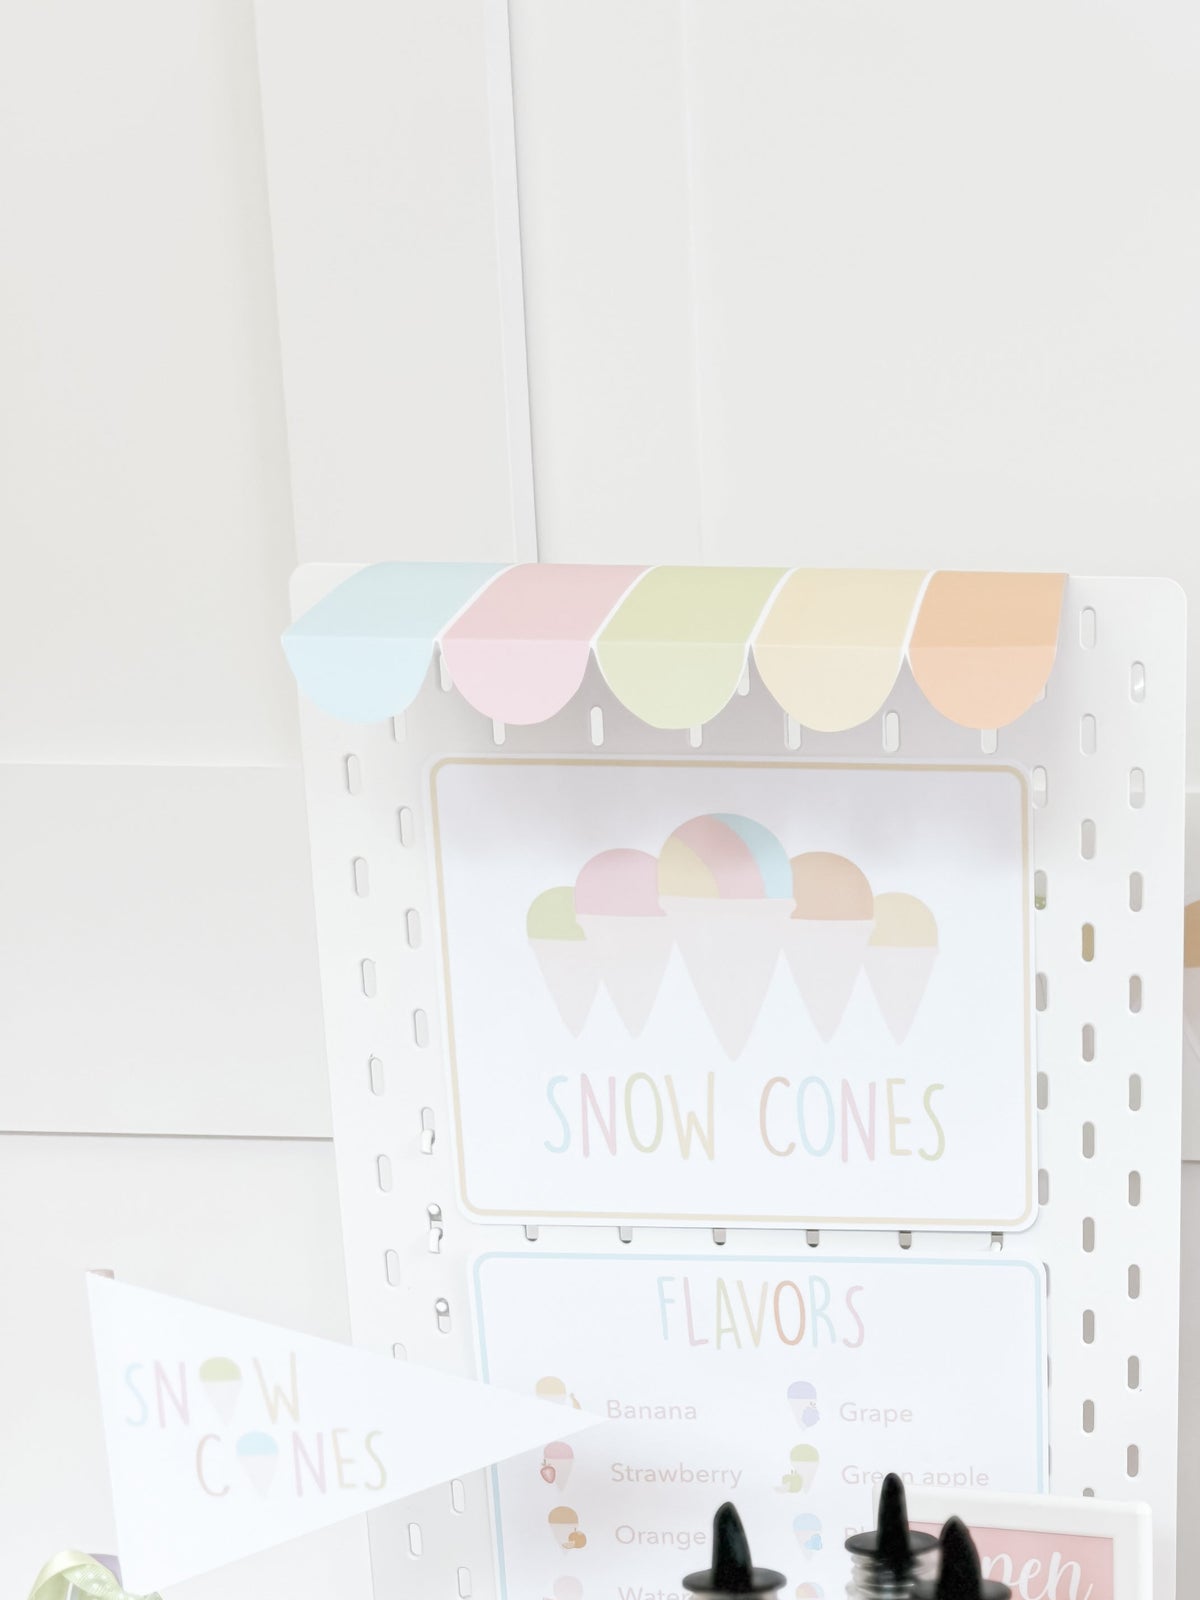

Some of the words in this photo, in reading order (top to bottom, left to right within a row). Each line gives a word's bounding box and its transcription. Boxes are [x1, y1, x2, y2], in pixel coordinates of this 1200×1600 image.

[544, 1071, 717, 1161] SNOW
[759, 1076, 946, 1162] CONES
[656, 1275, 866, 1351] FLAVORS
[606, 1398, 699, 1421] Banana
[839, 1402, 914, 1429] Grape
[610, 1461, 743, 1490] Strawberry
[841, 1465, 914, 1486] Gren
[923, 1465, 990, 1487] apple
[614, 1523, 707, 1549] Orange
